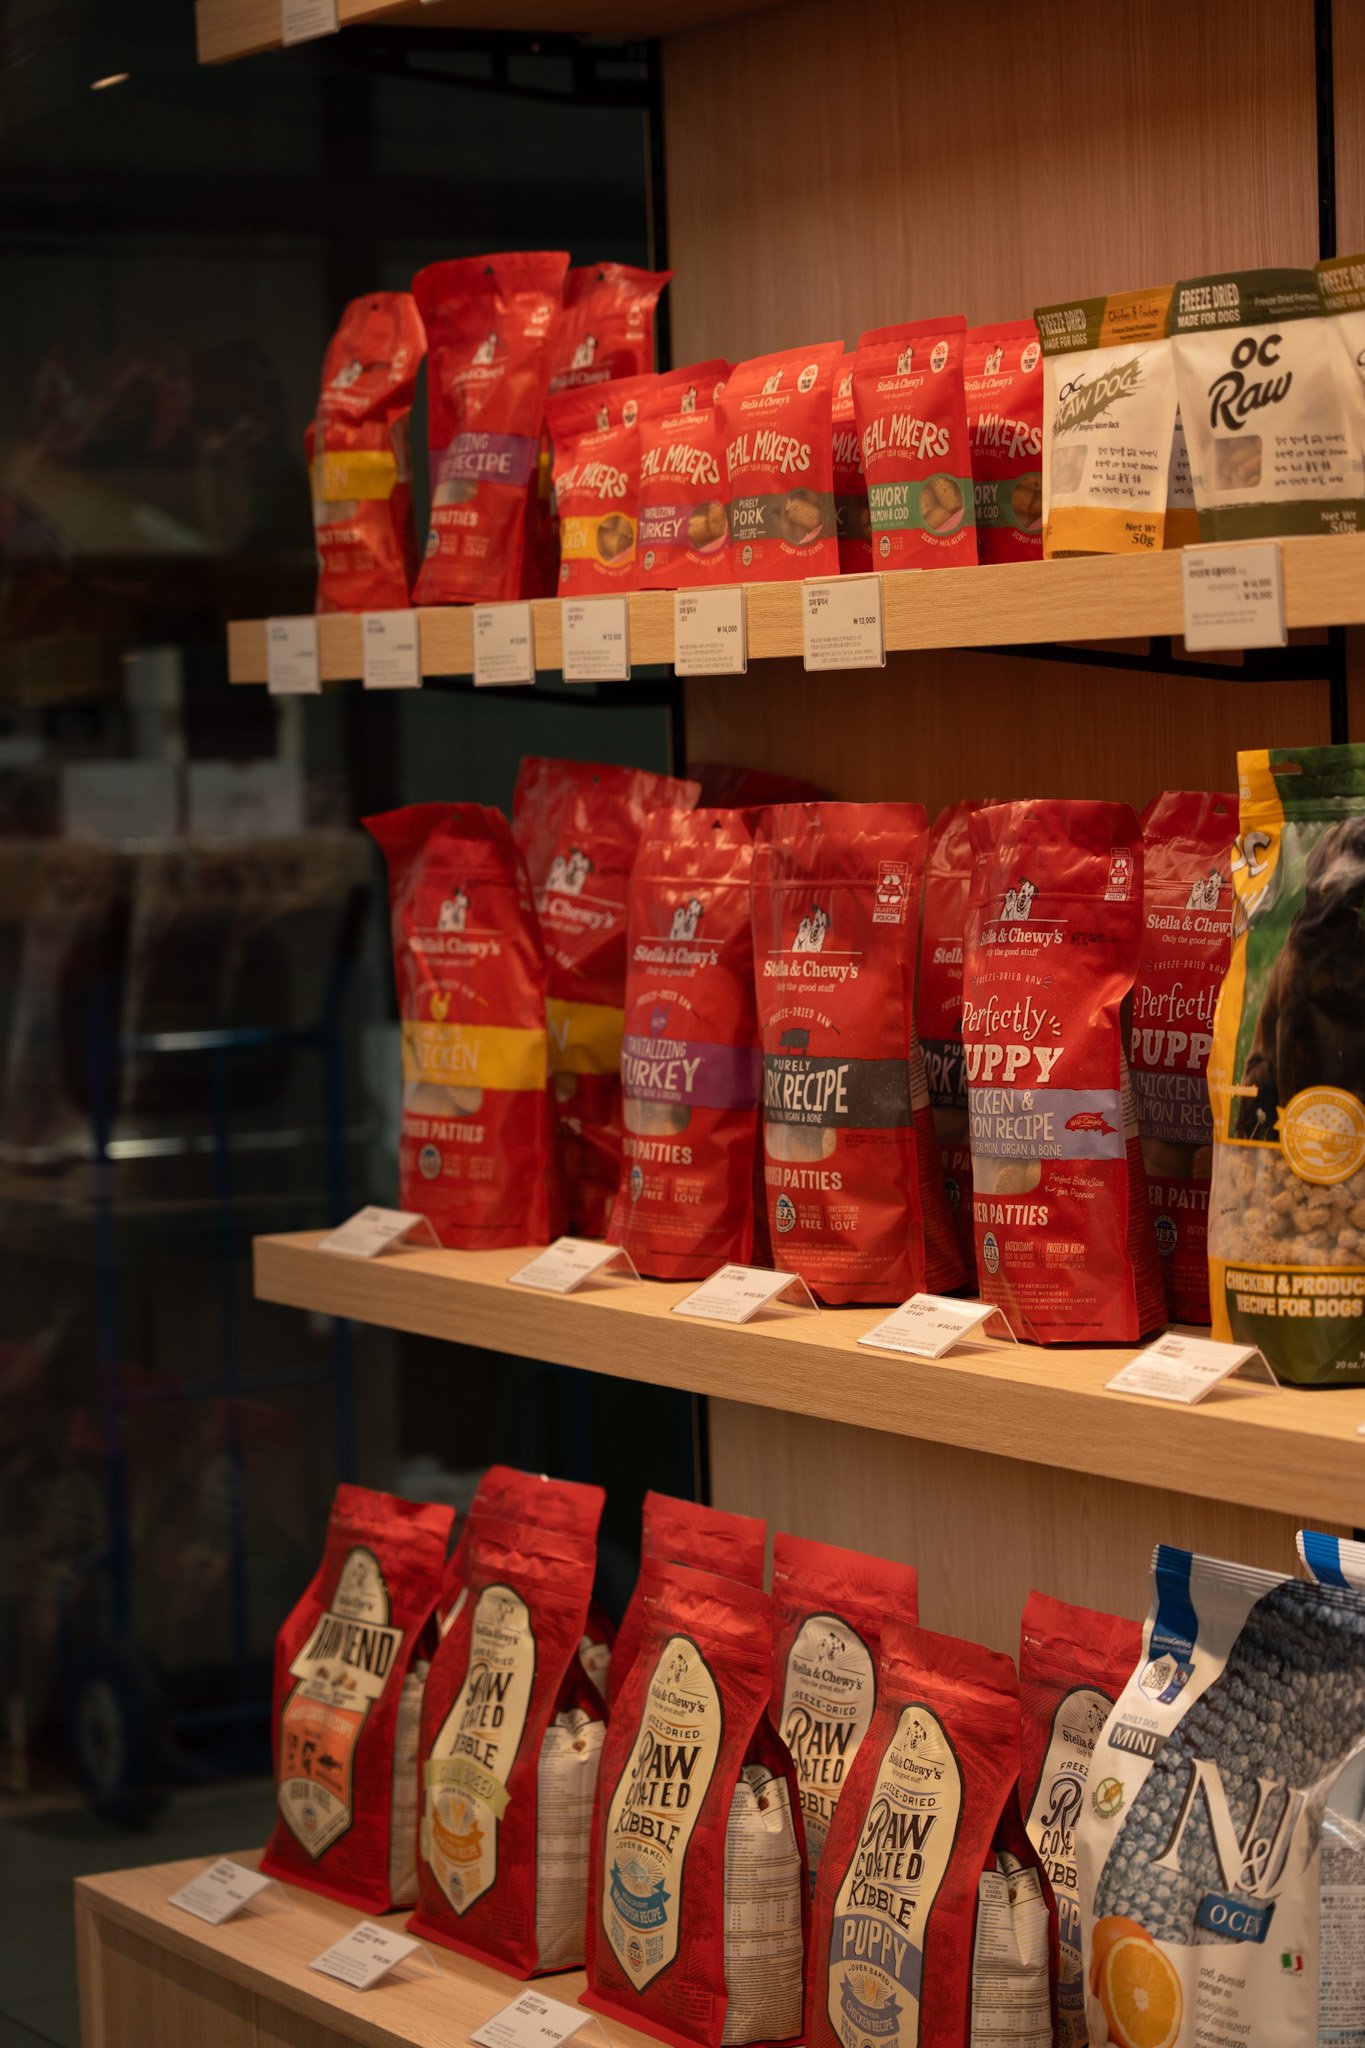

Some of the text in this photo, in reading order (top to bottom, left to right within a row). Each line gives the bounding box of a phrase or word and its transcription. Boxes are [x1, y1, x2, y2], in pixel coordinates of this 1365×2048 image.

[1179, 283, 1240, 312] FREEZE DRIED
[1039, 309, 1087, 336] FREEZE DRIED
[1109, 310, 1131, 322] Chicken
[1178, 309, 1241, 328] MADE FOR DOGS
[1044, 335, 1087, 350] MADE FOR DOGS
[1231, 333, 1282, 368] OC
[1056, 367, 1133, 428] RAW DOG
[1208, 371, 1292, 431] Raw
[890, 414, 949, 459] MIXERS
[977, 413, 1042, 460] MIXERS
[753, 430, 811, 474] MIXERS
[662, 444, 720, 486] MIXERS
[578, 460, 628, 500] MIXERS
[739, 498, 759, 510] PURELY
[871, 486, 909, 509] SAVORY
[734, 509, 764, 528] PORK
[894, 507, 909, 520] COD
[1321, 510, 1357, 522] Net Wt
[639, 518, 683, 540] TURKEY
[740, 528, 757, 540] RECIPE
[1125, 523, 1156, 534] Net Wt
[1132, 533, 1155, 547] 50g
[1146, 913, 1192, 931] Stella &
[997, 930, 1008, 944] &
[1008, 928, 1063, 947] Chewy's
[1162, 934, 1223, 946] Only the good stuff
[1004, 949, 1019, 958] good
[1020, 948, 1038, 956] stuff
[790, 960, 802, 977] &
[802, 961, 859, 983] Chewy's
[1154, 960, 1225, 975] FREEZE-DRIED RAW
[787, 983, 834, 994] the good stuff
[976, 972, 1043, 986] FREEZE-DRIED RAW
[770, 1006, 832, 1028] FREEZE-DRIED RAW
[962, 995, 1046, 1041] Perfectly
[1131, 1028, 1211, 1070] PUPP
[622, 1051, 702, 1093] TURKEY
[773, 1058, 811, 1072] PURELY
[965, 1044, 1065, 1083] UPPY
[784, 1064, 849, 1113] RECIPE
[1136, 1070, 1202, 1101] CHICKEN
[1022, 1091, 1034, 1112] &
[807, 1113, 823, 1124] BONE
[996, 1112, 1055, 1141] RECIPE
[432, 1122, 485, 1144] PATTIES
[1291, 1126, 1359, 1148] AMERICAN MADE
[639, 1142, 693, 1165] PATTIES
[1001, 1144, 1028, 1156] ORGAN
[1030, 1146, 1036, 1156] &
[1038, 1145, 1062, 1157] BONE
[784, 1170, 843, 1191] PATTIES
[1049, 1172, 1104, 1188] Perfect Bite Size
[643, 1190, 701, 1204] FREE LOVE
[1057, 1188, 1096, 1201] for Puppies
[800, 1220, 823, 1230] FREE
[830, 1220, 857, 1231] LOVE
[990, 1203, 1049, 1226] PATTIES
[984, 1247, 999, 1259] USA
[1046, 1243, 1085, 1255] PROTEIN RICH
[1226, 1270, 1365, 1296] CHICKEN & PRODUC
[1236, 1294, 1364, 1319] RECIPE FOR DOGS
[1335, 1361, 1346, 1370] 20
[812, 1670, 822, 1681] &
[822, 1670, 863, 1691] Chewy's
[667, 1693, 706, 1714] Chewy's
[787, 1706, 857, 1757] RAW
[1121, 1712, 1158, 1729] ADULT DOG
[1063, 1730, 1086, 1748] Stella
[1112, 1728, 1157, 1756] MINI
[903, 1758, 942, 1781] Chewy's
[879, 1781, 936, 1807] FREEZE-DRIED
[614, 1808, 681, 1854] KIBBLE
[862, 1798, 936, 1850] RAW
[618, 1842, 664, 1865] OVEN BAKED
[855, 1852, 923, 1881] COATED
[847, 1876, 916, 1930] KIBBLE
[640, 1907, 663, 1924] RECIPE
[840, 1918, 907, 1980] PUPPY
[851, 1963, 890, 1985] OVEN BAKED
[1200, 1968, 1216, 1980] cod,
[1198, 1980, 1223, 1996] orange
[846, 2001, 894, 2031] CHICKEN RECIPE
